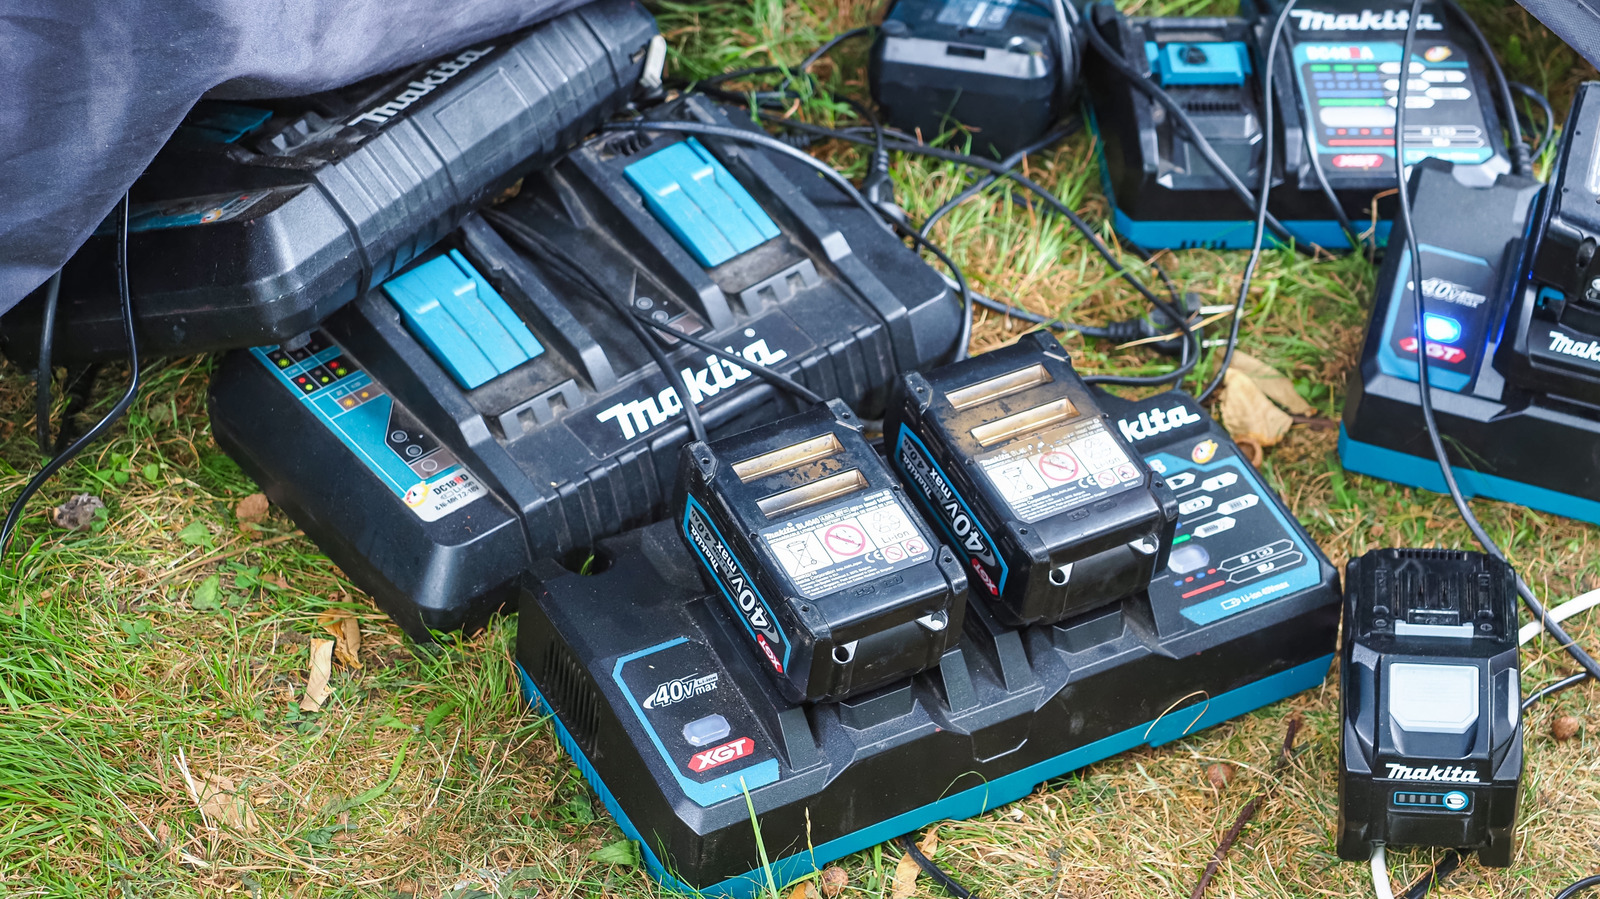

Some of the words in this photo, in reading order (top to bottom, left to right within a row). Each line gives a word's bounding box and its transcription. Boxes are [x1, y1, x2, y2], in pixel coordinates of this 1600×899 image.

[1289, 9, 1443, 31] Makita
[347, 45, 496, 127] Makita
[596, 338, 788, 441] Makita
[453, 481, 474, 493] Li-ion
[902, 453, 932, 500] Makita
[929, 467, 953, 499] max
[690, 525, 719, 573] Makita
[881, 530, 910, 544] Li-ion
[716, 540, 737, 574] max
[973, 563, 997, 593] XGT
[758, 640, 781, 670] XGT
[695, 681, 718, 695] max
[696, 738, 746, 770] XGT
[1385, 762, 1481, 783] Makita
